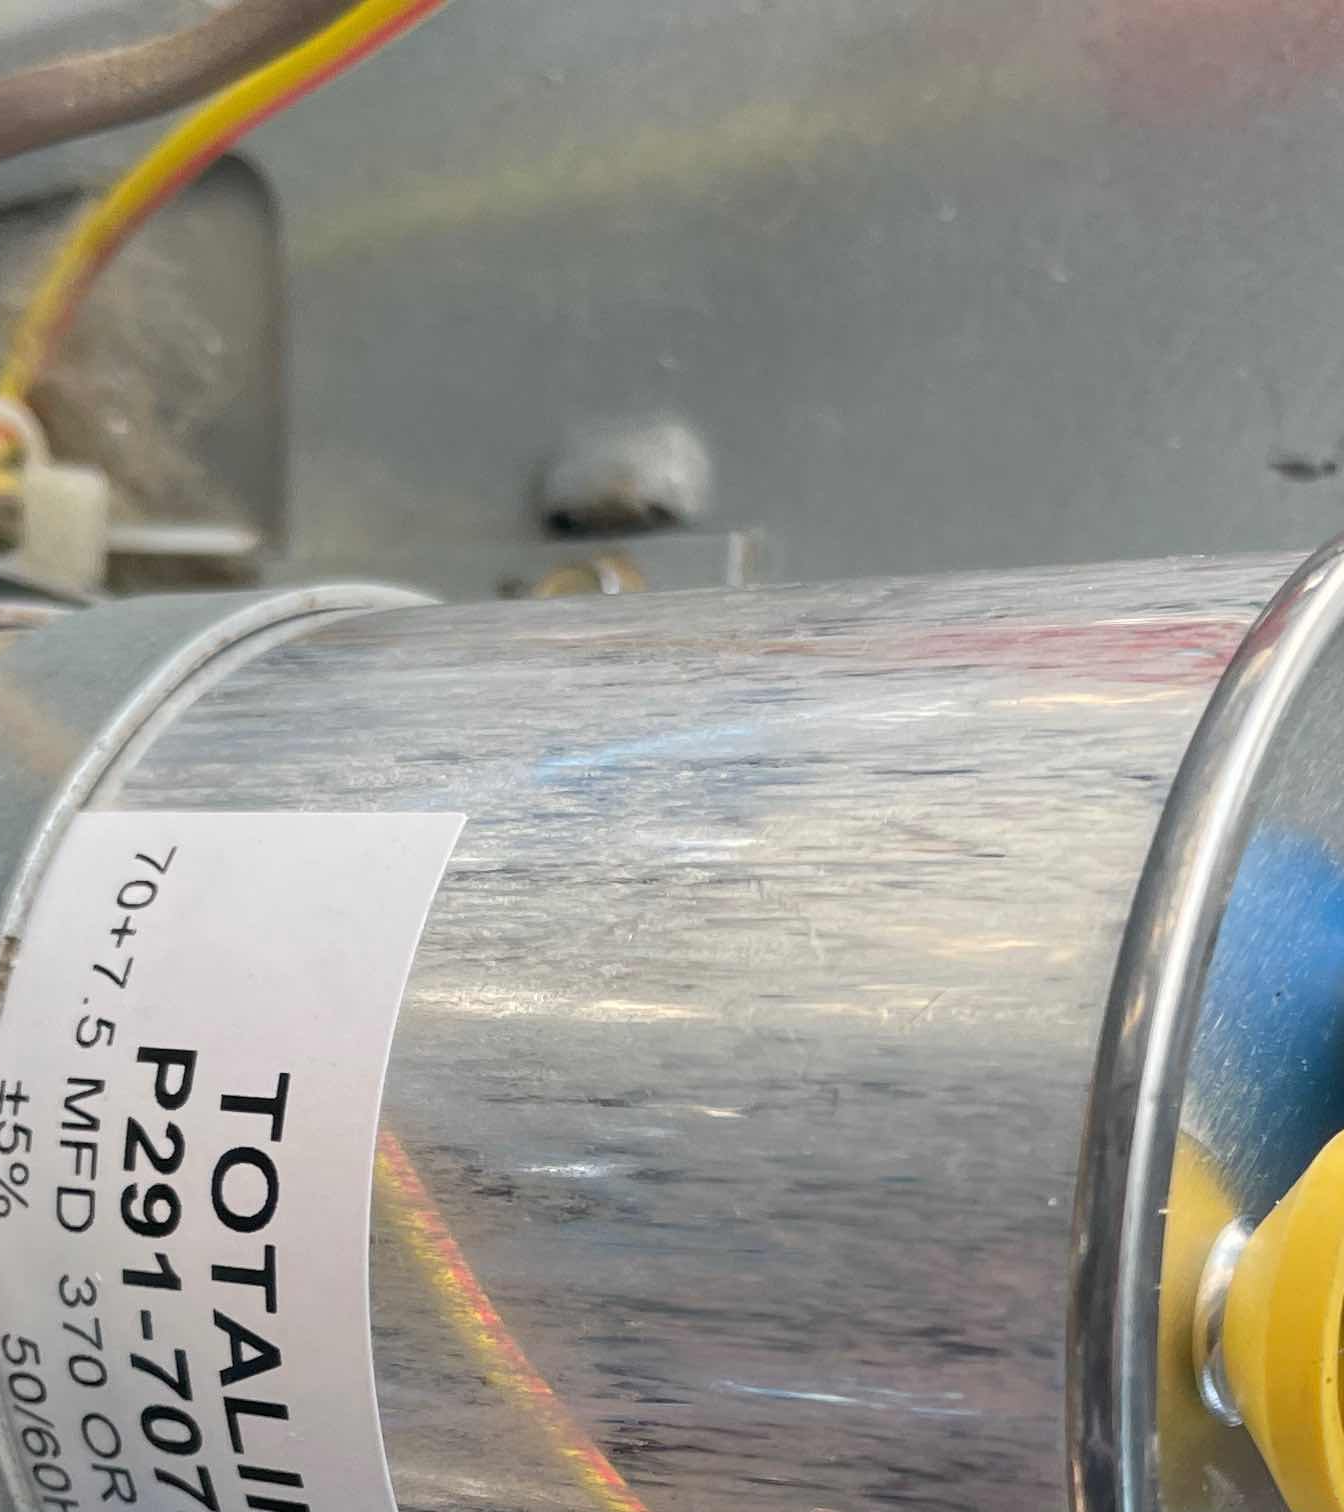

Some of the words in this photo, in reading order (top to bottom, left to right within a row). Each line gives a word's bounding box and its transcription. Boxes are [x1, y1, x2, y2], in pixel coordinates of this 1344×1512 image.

[70, 844, 175, 1050] 70+7.5
[52, 1076, 101, 1235] MFD
[57, 1273, 102, 1388] 370
[77, 1412, 137, 1503] OR
